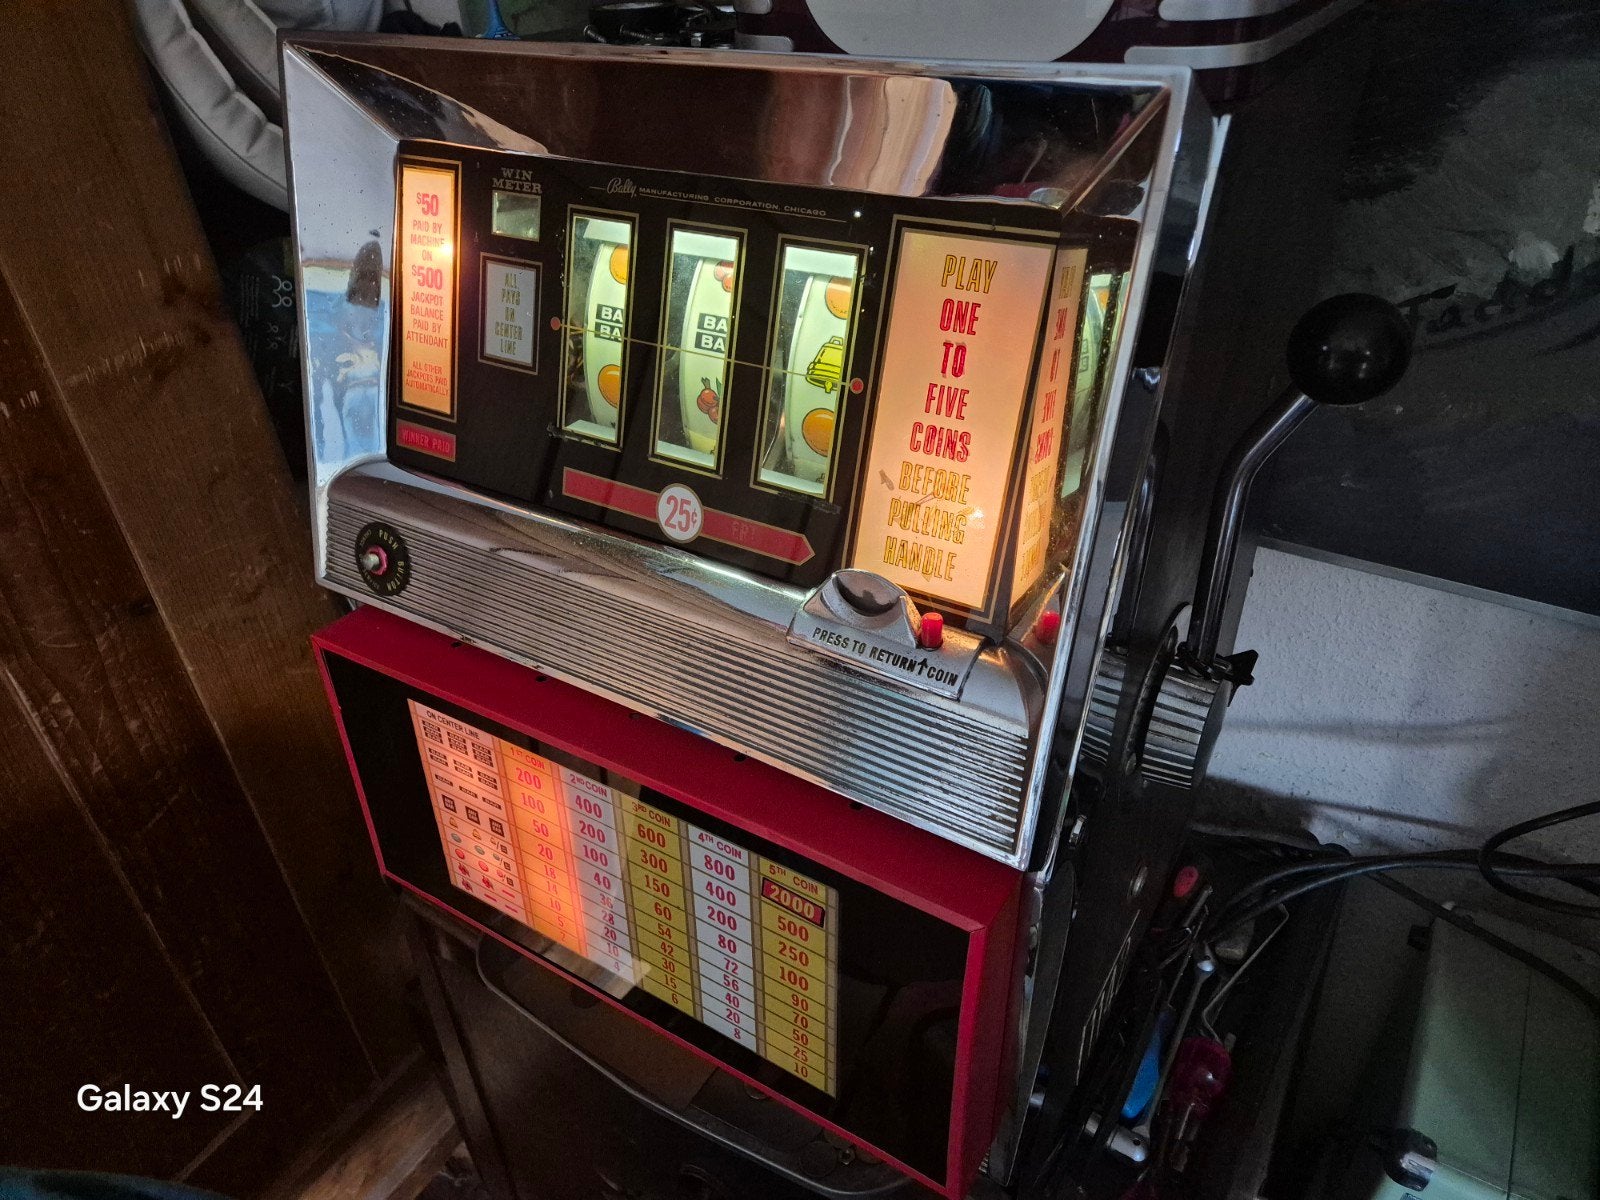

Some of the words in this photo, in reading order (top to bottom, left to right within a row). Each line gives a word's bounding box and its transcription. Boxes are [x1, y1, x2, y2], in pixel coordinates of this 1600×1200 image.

[501, 167, 533, 181] WIN
[492, 178, 543, 194] METER
[416, 192, 439, 216] $50
[638, 187, 710, 202] MANUFACTURING
[784, 205, 827, 217] CHICAGO
[412, 220, 430, 232] PAID
[432, 222, 442, 234] BY
[410, 234, 445, 248] MACHINE
[422, 249, 432, 262] ON
[412, 264, 443, 290] $500
[941, 254, 998, 294] PLAY
[411, 291, 444, 306] JACKPOT
[410, 304, 444, 321] BALANCE
[940, 298, 982, 336] ONE
[412, 318, 428, 331] PAID
[432, 322, 442, 334] BY
[406, 330, 448, 349] ATTENDANT
[940, 341, 967, 378] TO
[924, 382, 970, 420] FIVE
[402, 430, 430, 448] WINNER
[432, 438, 450, 453] PAID
[910, 422, 972, 462] COINS
[898, 461, 972, 506] BEFORE
[888, 497, 968, 544] PULLING
[883, 535, 958, 582] HANDLE
[812, 626, 850, 650] PRESS
[850, 639, 868, 655] TO
[868, 646, 918, 672] RETURN
[926, 666, 959, 686] COIN
[426, 710, 436, 721] ON
[439, 716, 465, 733] CENTER
[464, 728, 480, 740] LINE
[526, 755, 546, 770] COIN
[516, 767, 542, 790] 200
[586, 780, 608, 798] COIN
[521, 792, 546, 814] 100
[576, 794, 602, 819] 400
[648, 810, 671, 828] COIN
[532, 819, 550, 838] 50
[579, 820, 606, 844] 200
[638, 823, 666, 848] 600
[538, 843, 554, 860] 20
[698, 832, 714, 844] 4TH
[716, 841, 742, 860] COIN
[583, 844, 608, 868] 100
[640, 850, 668, 874] 300
[544, 864, 556, 880] 18
[704, 854, 736, 881] 800
[546, 880, 558, 895] 14
[594, 872, 612, 890] 40
[644, 874, 670, 898] 150
[768, 864, 786, 876] 5TH
[792, 876, 818, 895] COIN
[600, 893, 614, 910] 36
[706, 880, 736, 906] 400
[770, 884, 815, 920] 2000
[550, 898, 561, 912] 10
[654, 902, 672, 921] 60
[558, 916, 564, 928] 5
[602, 910, 615, 926] 28
[707, 906, 738, 931] 200
[604, 926, 616, 942] 20
[658, 922, 672, 940] 54
[778, 915, 809, 943] 500
[606, 942, 620, 958] 10
[660, 942, 674, 958] 42
[718, 934, 738, 954] 80
[778, 940, 810, 968] 250
[614, 961, 620, 972] 4
[662, 958, 676, 973] 30
[724, 957, 738, 975] 72
[664, 974, 678, 990] 15
[723, 974, 740, 992] 56
[780, 966, 809, 992] 100
[672, 993, 678, 1004] 6
[724, 992, 740, 1008] 40
[791, 994, 808, 1012] 90
[726, 1008, 740, 1024] 20
[792, 1011, 808, 1029] 70
[734, 1027, 741, 1040] 8
[792, 1028, 808, 1046] 50
[792, 1045, 808, 1062] 25
[794, 1062, 808, 1078] 10
